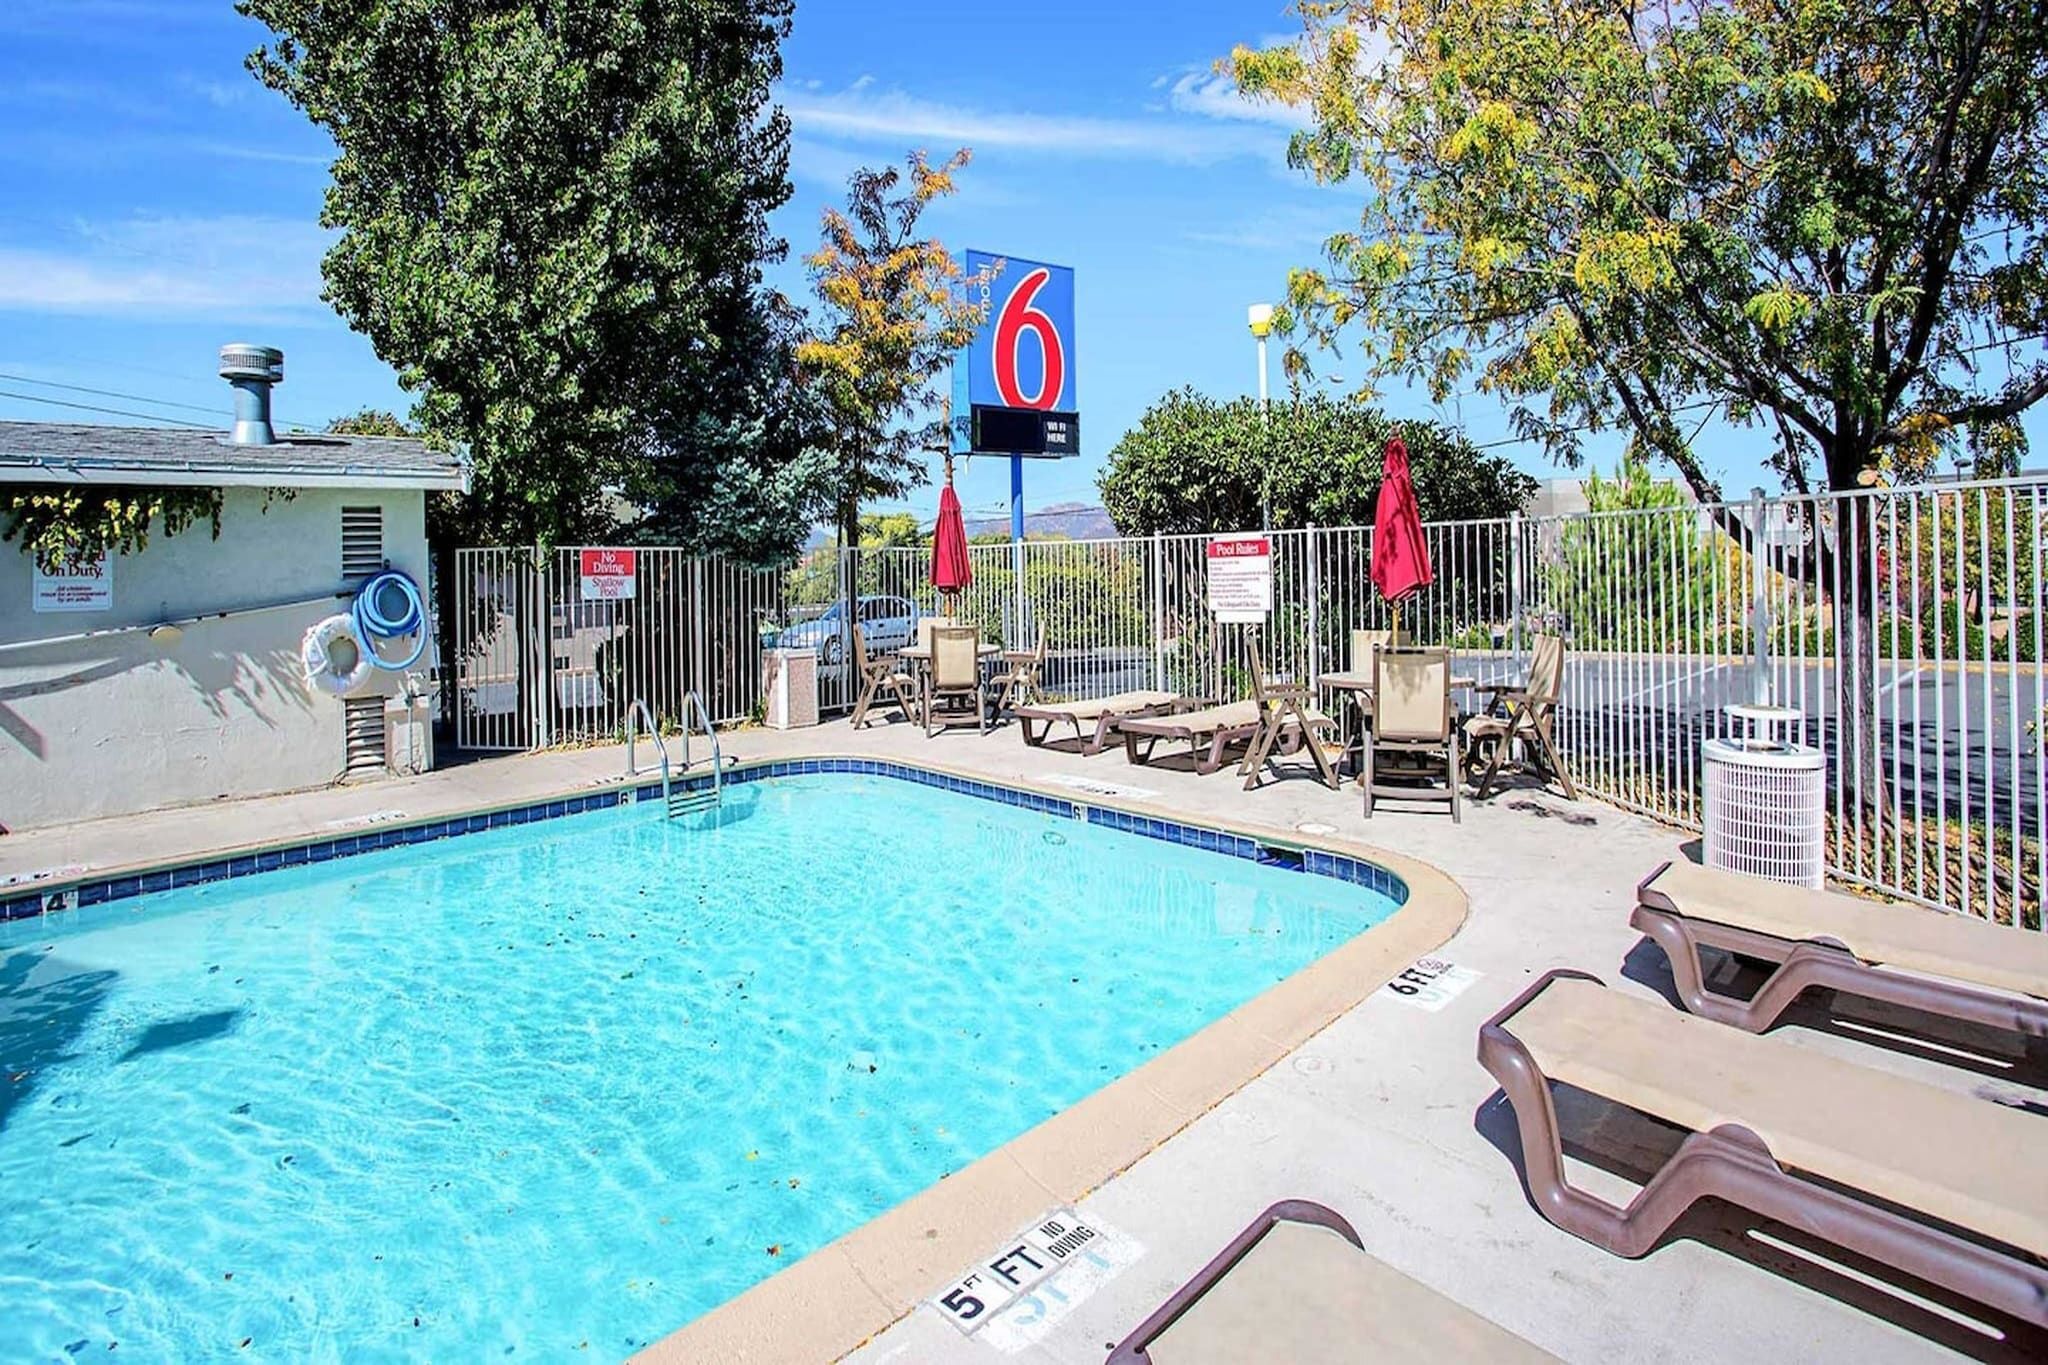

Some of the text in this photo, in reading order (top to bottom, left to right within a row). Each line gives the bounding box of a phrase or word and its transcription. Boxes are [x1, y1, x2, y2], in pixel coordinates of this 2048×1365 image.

[977, 263, 992, 317] mol
[992, 267, 1066, 411] 6
[1047, 432, 1067, 444] HERE
[601, 551, 616, 563] No
[1216, 543, 1260, 556] Pool Rules
[592, 562, 625, 574] Diving
[592, 577, 625, 587] Shallow
[600, 586, 619, 597] Pool
[1040, 1220, 1066, 1240] NO
[1047, 1225, 1095, 1259] DIVING
[989, 1245, 1044, 1286] FT
[962, 1273, 983, 1290] FT
[940, 1288, 985, 1320] 5
